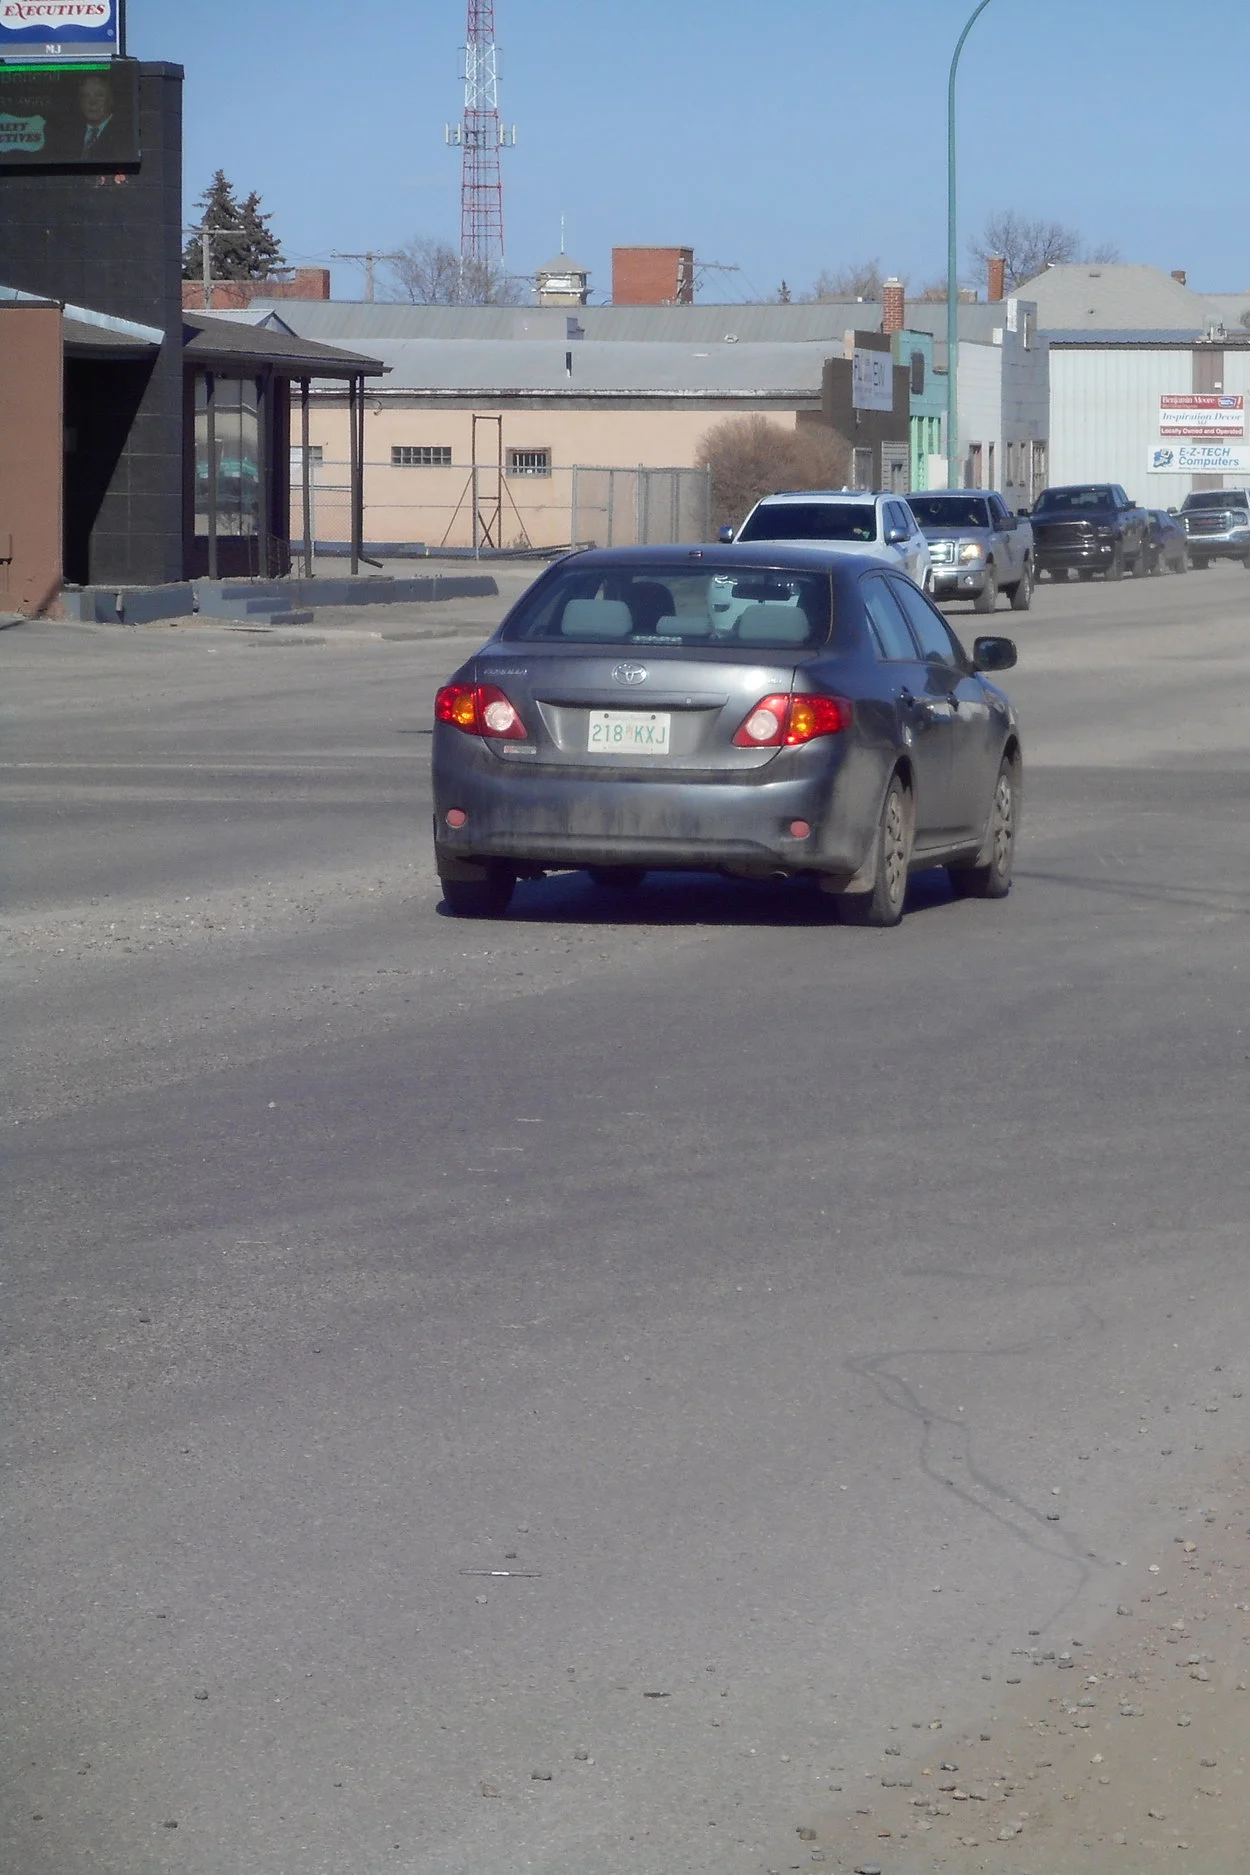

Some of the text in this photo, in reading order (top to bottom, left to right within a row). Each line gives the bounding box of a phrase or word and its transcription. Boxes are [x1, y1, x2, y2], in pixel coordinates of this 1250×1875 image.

[4, 3, 106, 20] EXECUTIVES
[1162, 396, 1192, 405] Benjamin
[1194, 396, 1215, 404] Moore
[1162, 412, 1213, 422] Inspiration
[1161, 427, 1181, 435] Locally
[1182, 427, 1204, 435] Owned
[1216, 427, 1243, 435] Operated
[1179, 447, 1231, 457] E-Z-TECH
[1178, 456, 1239, 467] Computers
[592, 724, 666, 744] 218 KXJ
